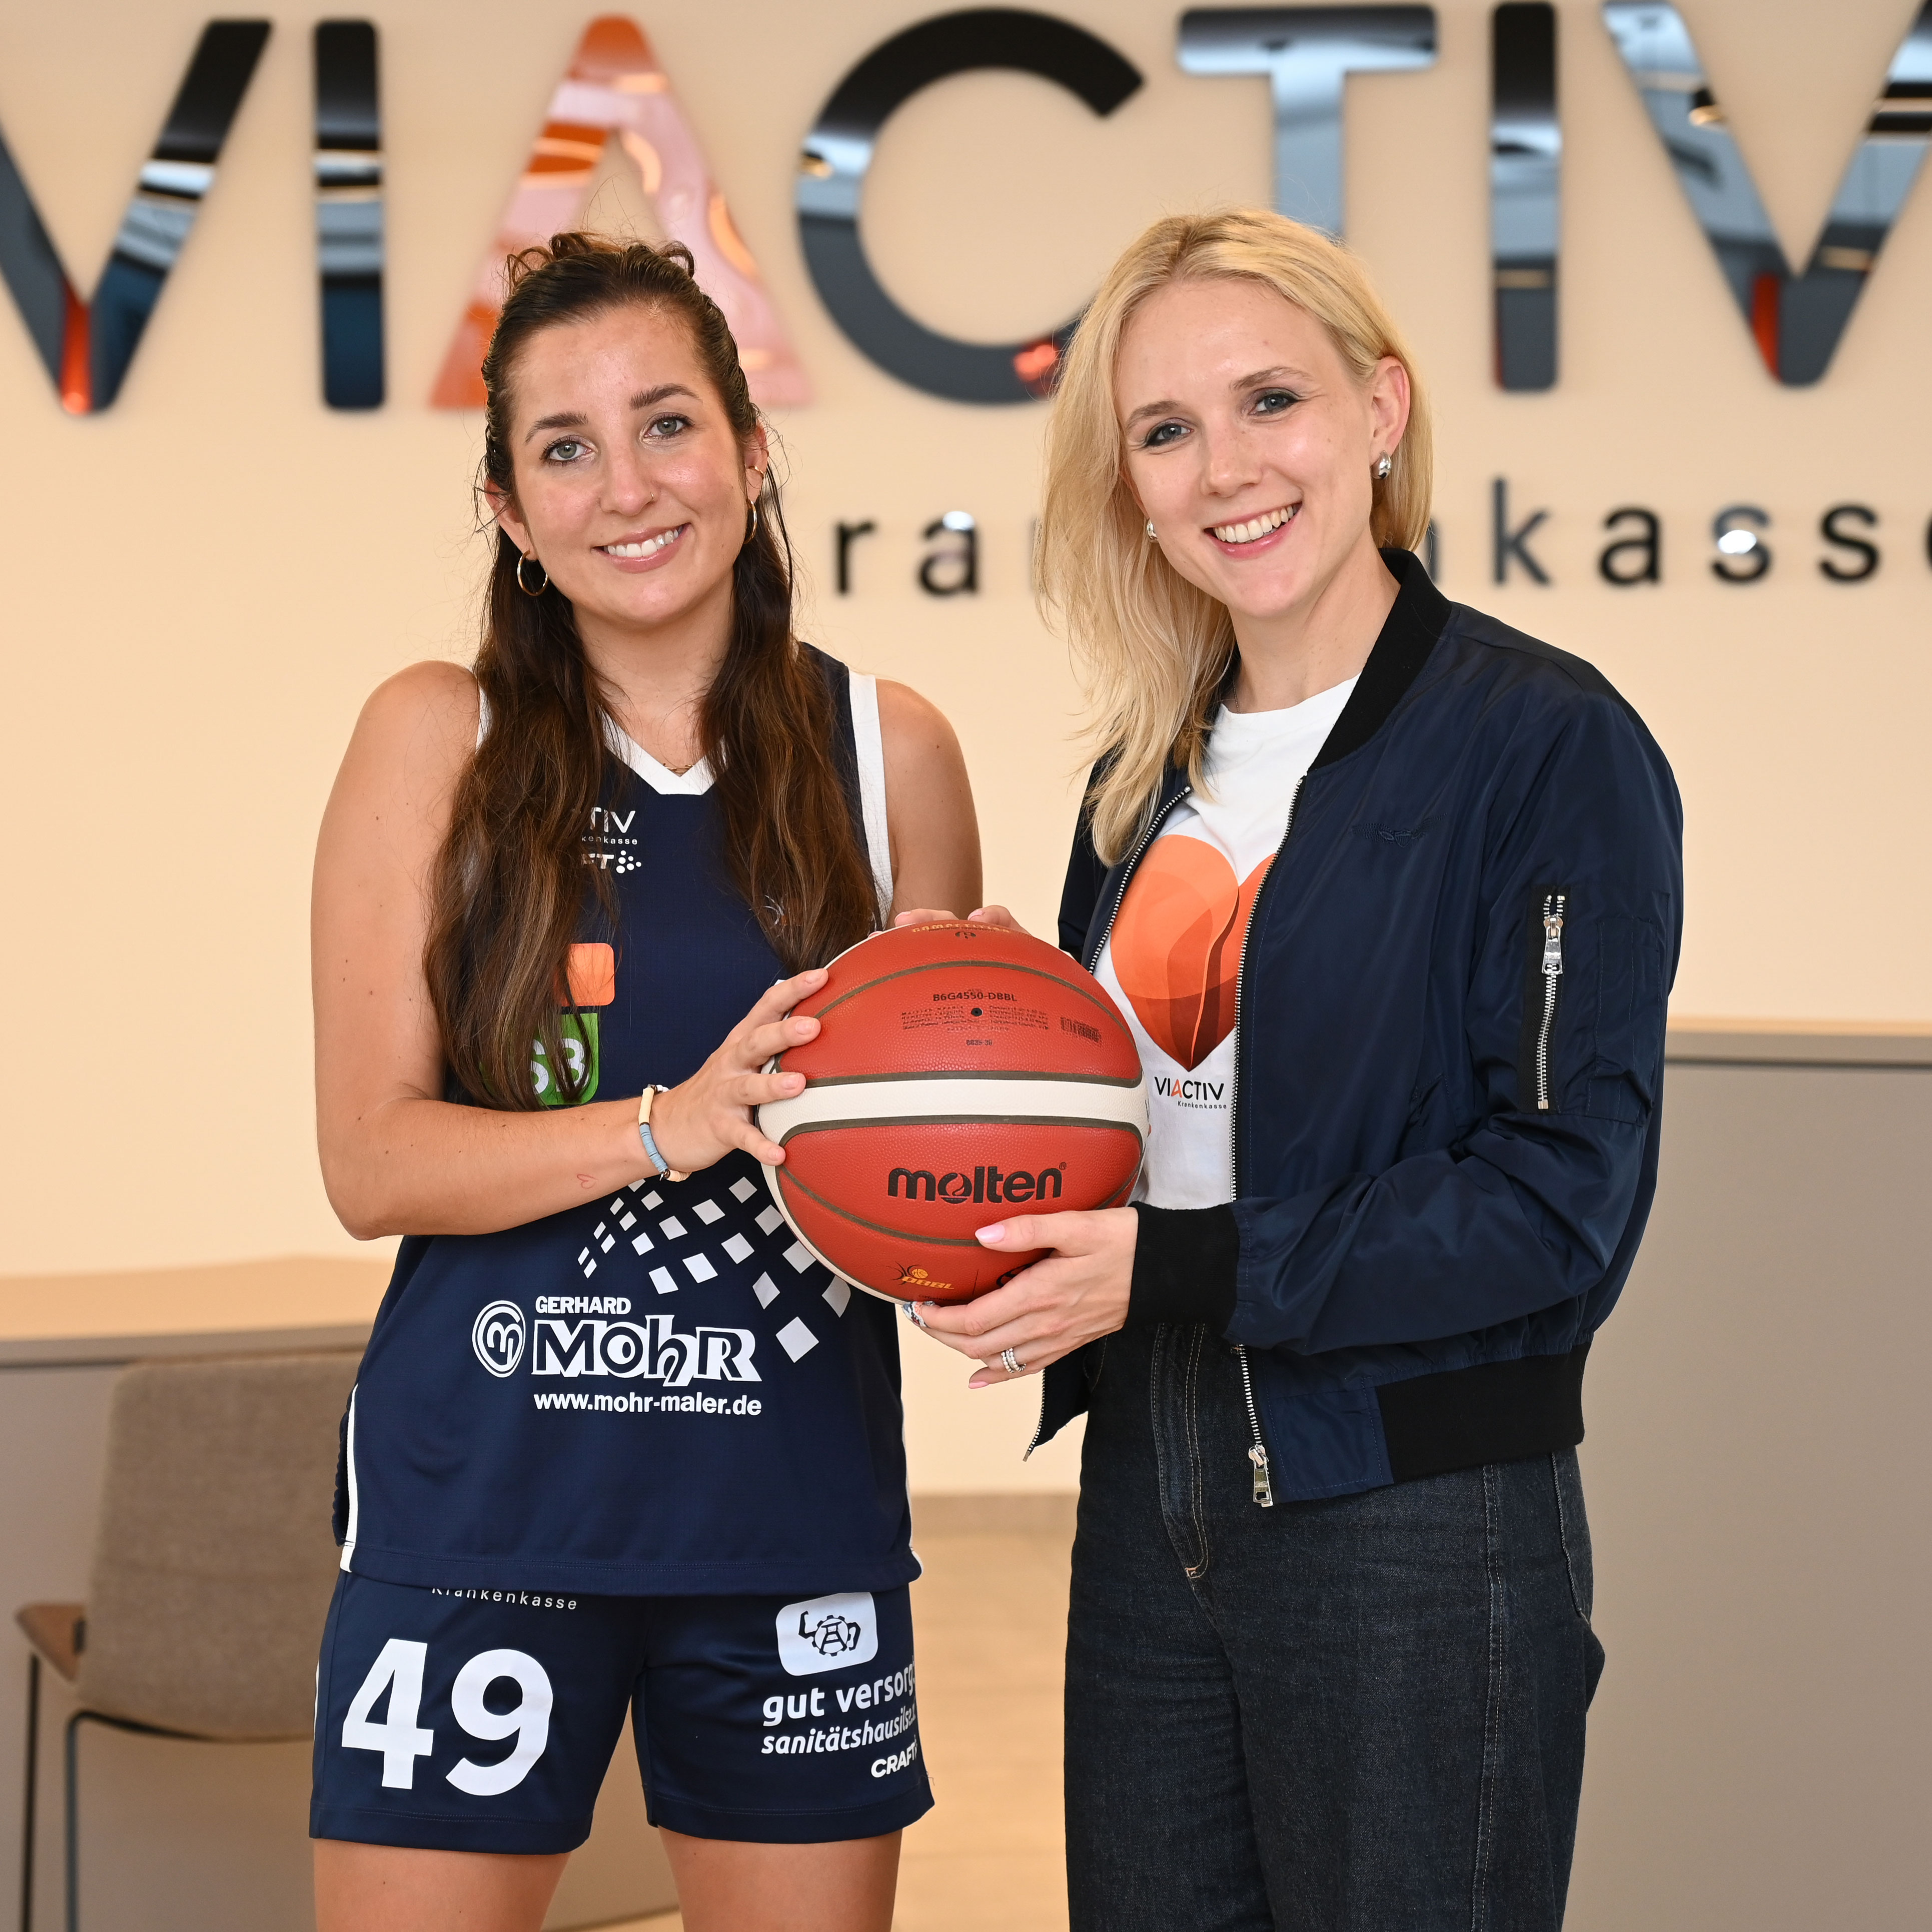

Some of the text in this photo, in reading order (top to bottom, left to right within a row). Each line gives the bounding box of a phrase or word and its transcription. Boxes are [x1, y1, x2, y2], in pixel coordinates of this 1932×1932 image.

[933, 992, 1017, 1003] B6G4550-DBBL
[1154, 1077, 1224, 1100] VIACTIV
[1178, 1101, 1227, 1109] Krankenkasse
[535, 1296, 631, 1315] GERHARD
[533, 1392, 762, 1416] www.mohr-maler.de
[341, 1638, 553, 1796] 49
[762, 1687, 825, 1727] gut
